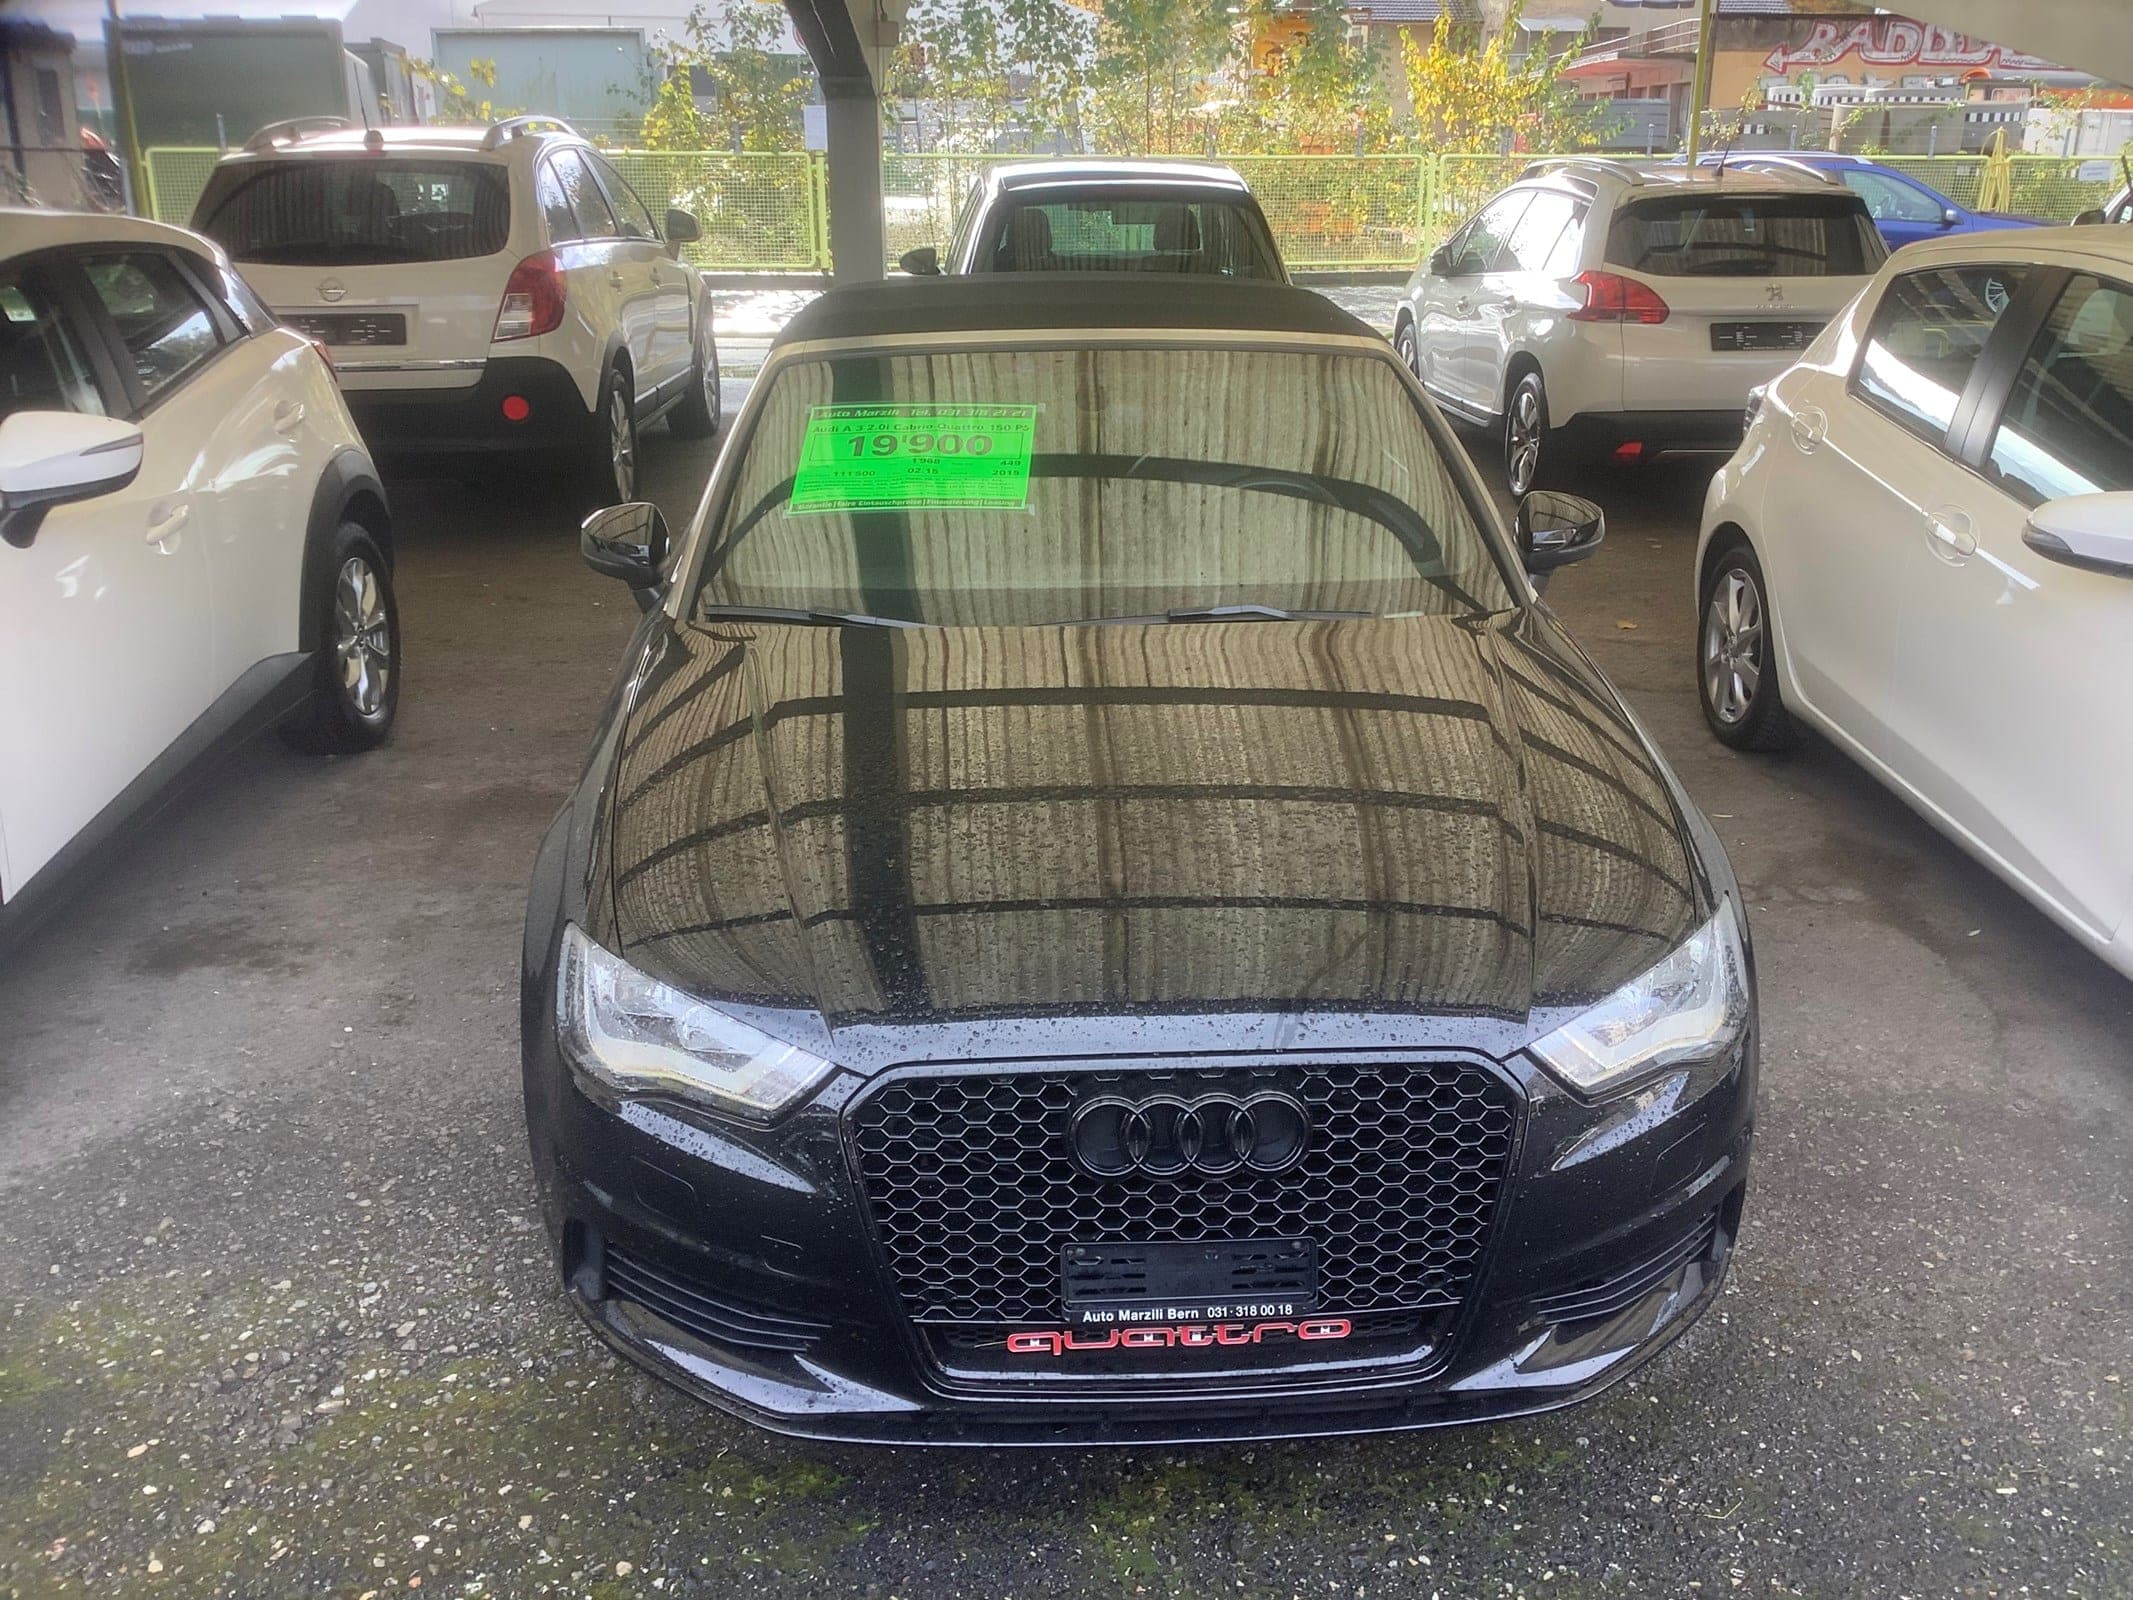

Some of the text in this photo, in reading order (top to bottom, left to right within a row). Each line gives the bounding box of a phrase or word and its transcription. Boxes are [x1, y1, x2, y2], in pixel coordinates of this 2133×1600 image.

[813, 425, 838, 433] Audi
[894, 423, 934, 431] Cabrio
[938, 423, 984, 431] Quattro
[1015, 424, 1030, 432] PS
[848, 433, 993, 457] 19'900
[1082, 1310, 1114, 1323] Auto
[1118, 1308, 1163, 1321] Marzili
[1167, 1307, 1199, 1320] Bern
[1260, 1304, 1276, 1316] 00
[1278, 1303, 1294, 1315] 18
[1006, 1318, 1352, 1356] quattro
